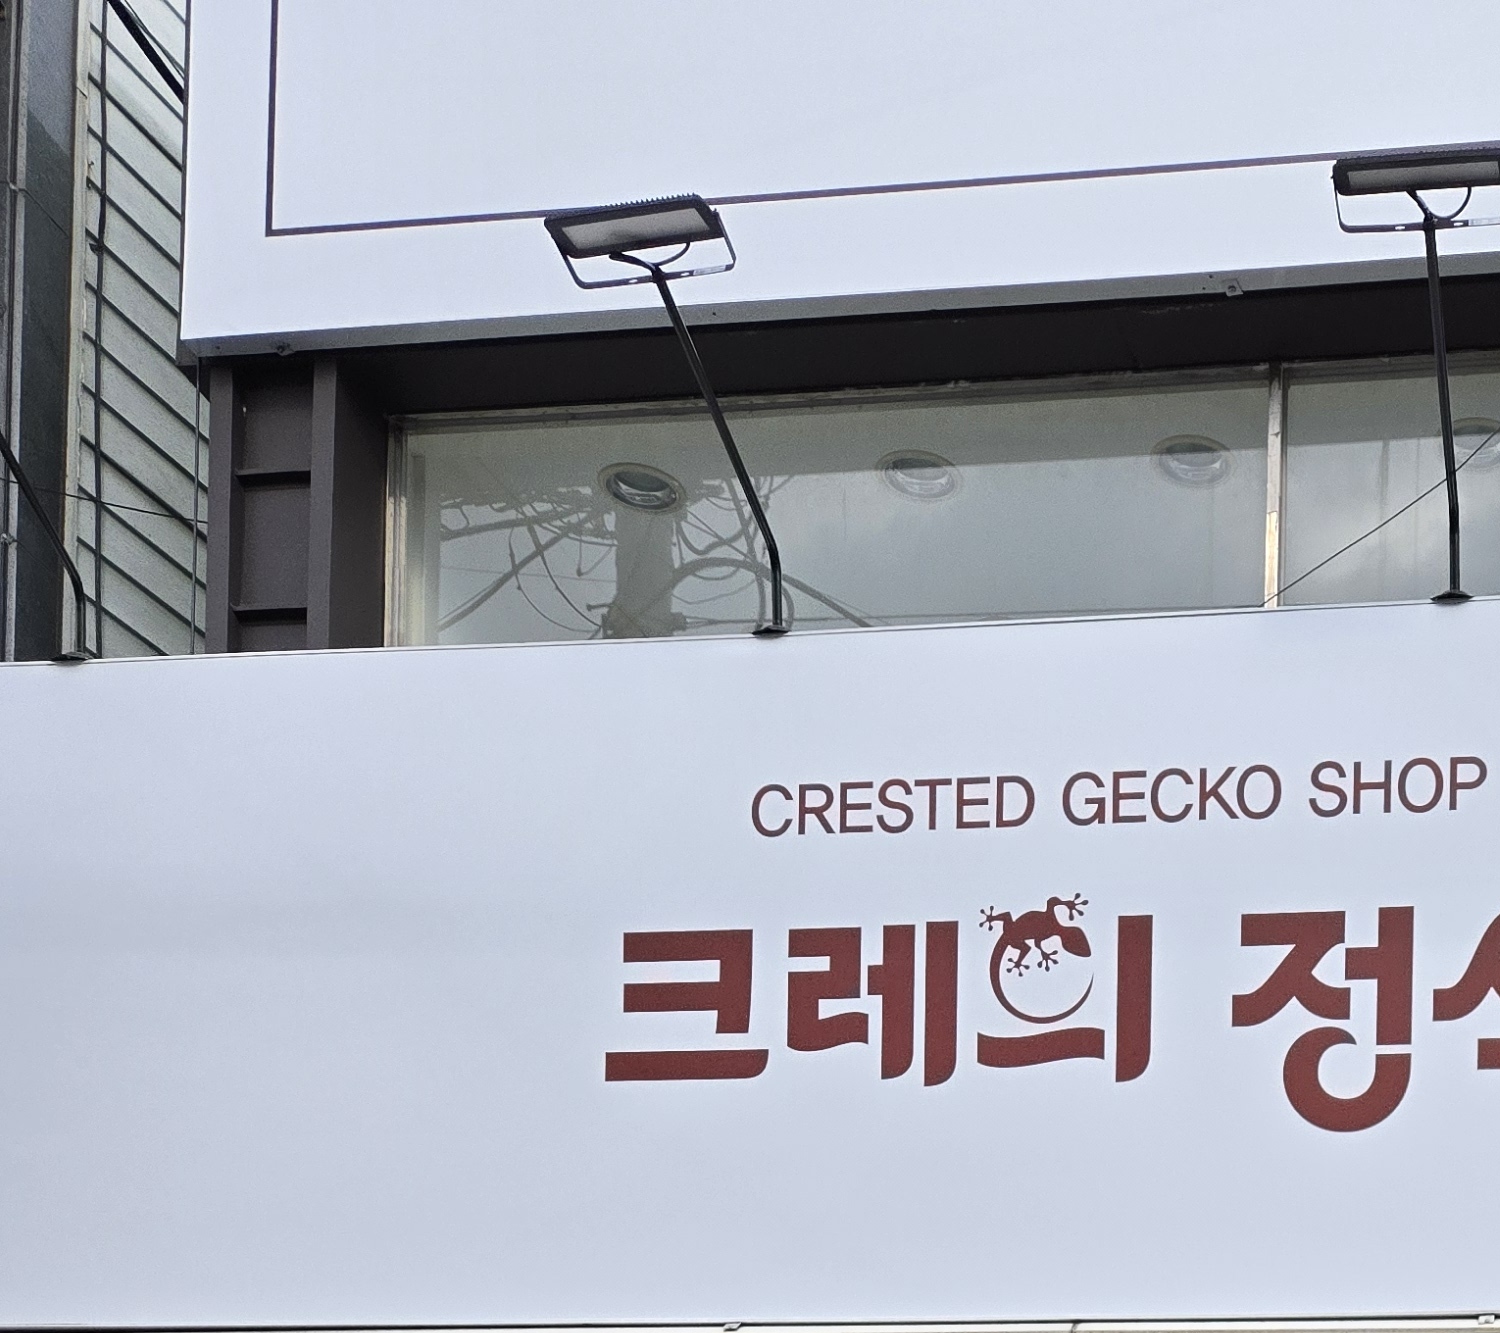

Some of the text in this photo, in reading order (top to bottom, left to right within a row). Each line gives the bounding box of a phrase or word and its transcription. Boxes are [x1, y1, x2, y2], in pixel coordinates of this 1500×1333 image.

[751, 756, 1489, 839] CRESTED GECKO SHOP
[604, 893, 1154, 1088] 크레의
